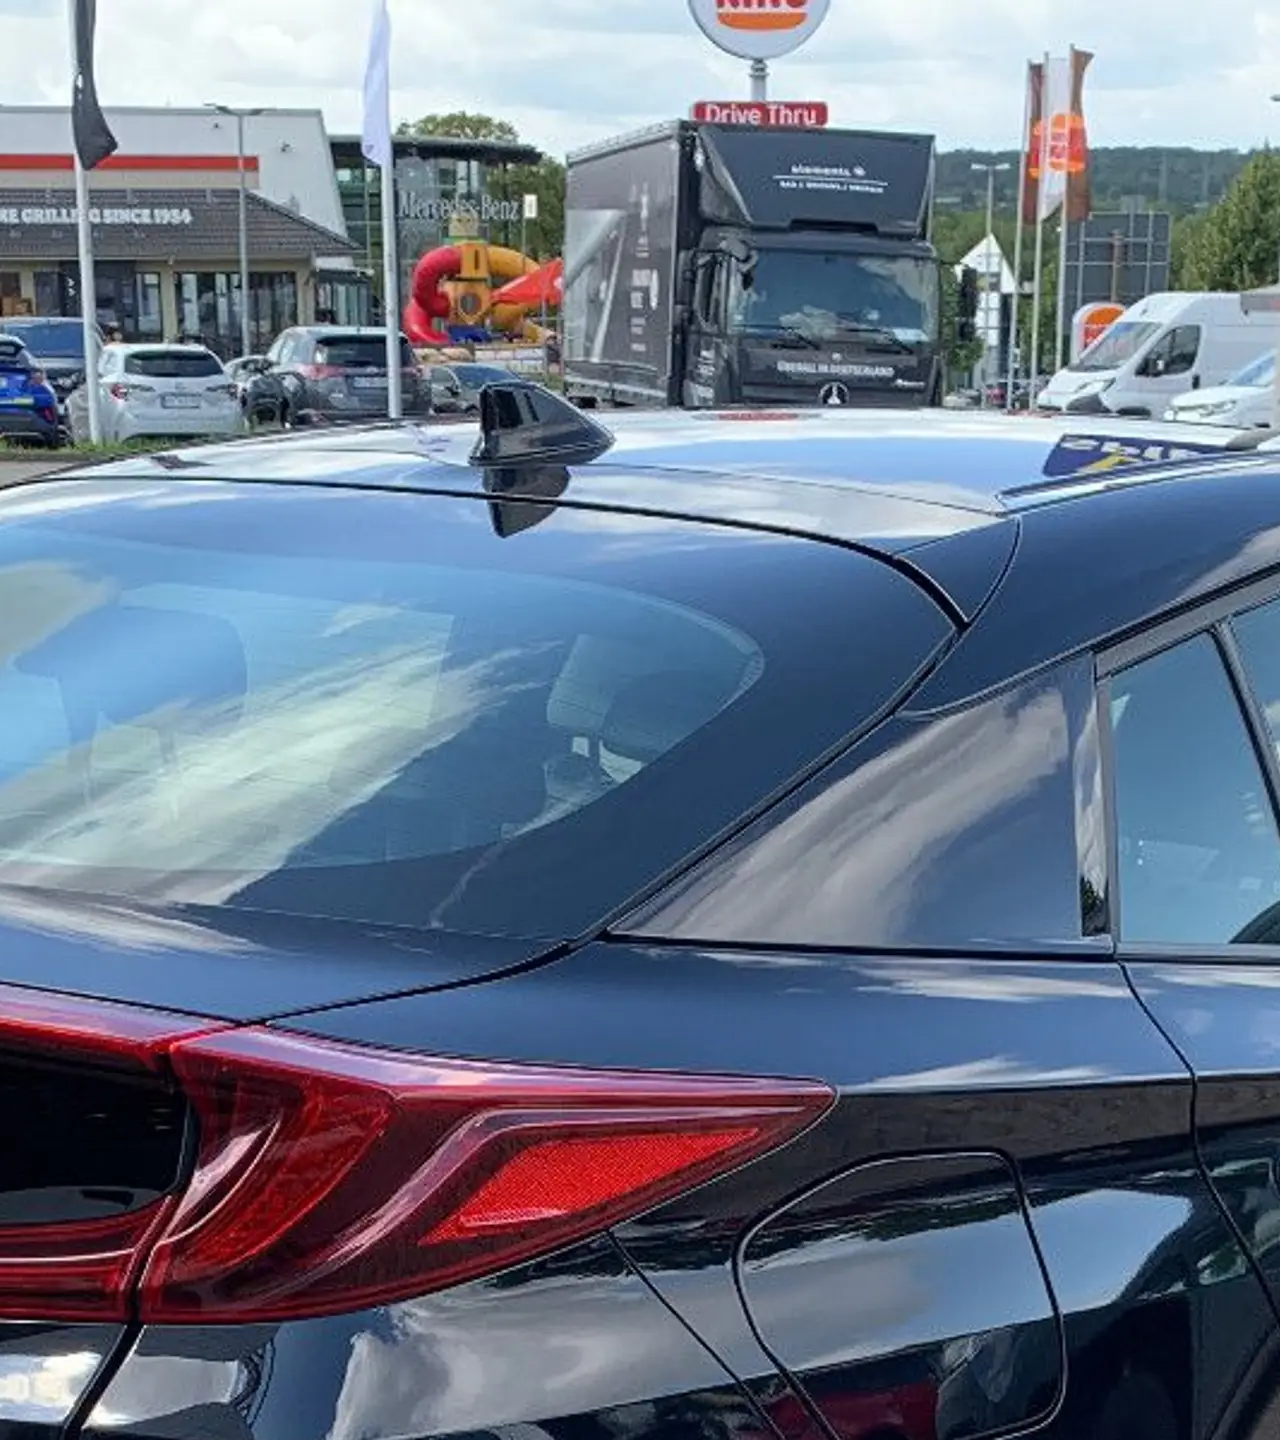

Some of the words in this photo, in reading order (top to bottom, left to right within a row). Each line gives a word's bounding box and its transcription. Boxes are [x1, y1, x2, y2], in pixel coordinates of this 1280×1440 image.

[705, 103, 761, 125] Drive
[766, 104, 818, 126] Thru
[21, 208, 101, 224] GRILLIG
[103, 208, 152, 224] SINCE
[153, 208, 193, 225] 1954
[399, 191, 519, 220] Mercedes-Benz
